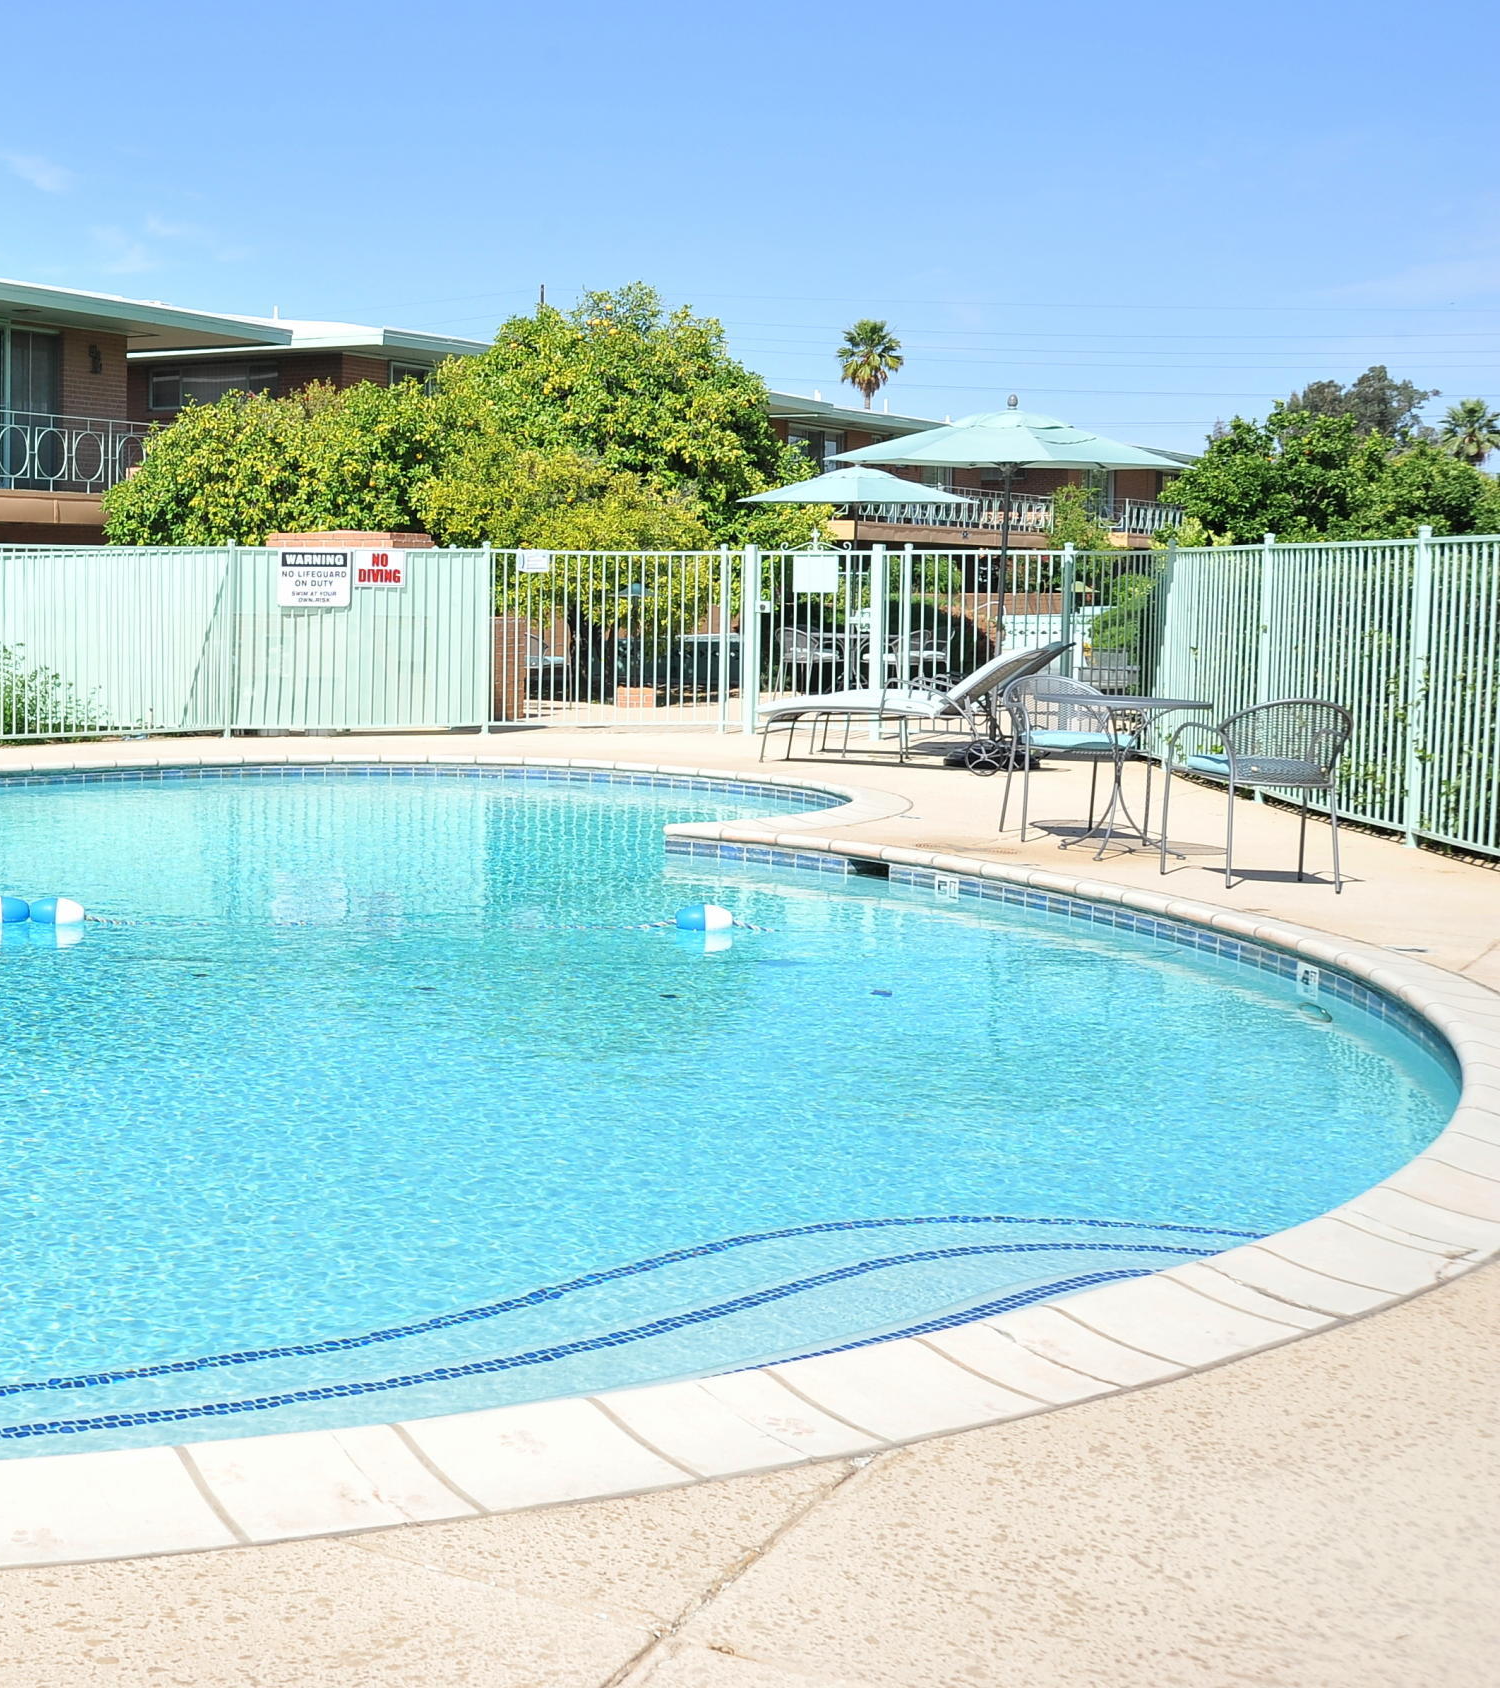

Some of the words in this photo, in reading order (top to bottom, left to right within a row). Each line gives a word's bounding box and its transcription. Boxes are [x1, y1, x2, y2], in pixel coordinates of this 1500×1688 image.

[285, 554, 344, 565] WARNING
[372, 553, 388, 567] NO
[297, 570, 347, 578] LIFEGUARD
[358, 569, 401, 583] DIVING
[294, 579, 307, 587] ON
